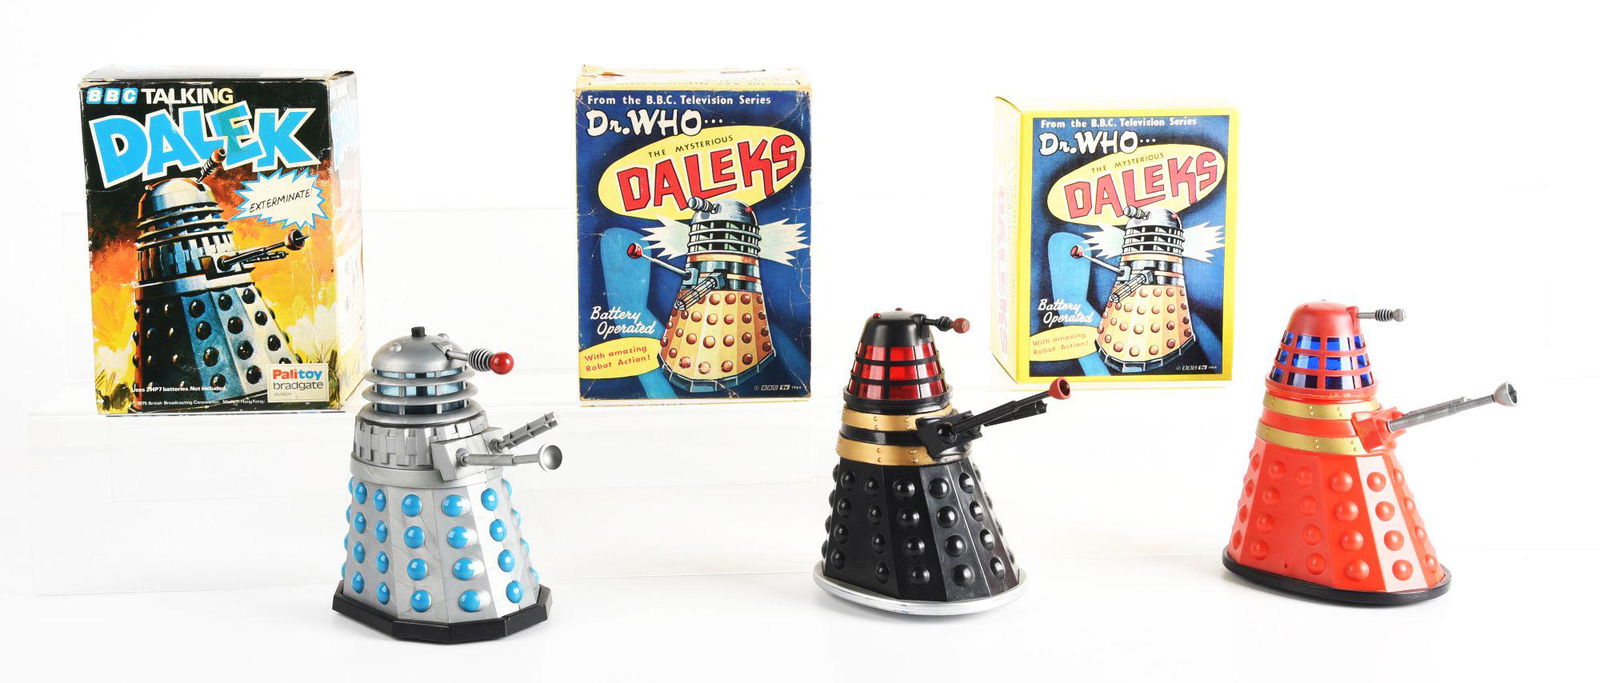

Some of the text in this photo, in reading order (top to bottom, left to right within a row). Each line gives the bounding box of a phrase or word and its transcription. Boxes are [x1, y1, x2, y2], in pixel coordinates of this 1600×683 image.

[86, 87, 234, 105] BBC TALKING
[587, 94, 771, 105] From the B.B.C. Television Series
[1040, 117, 1198, 128] From the B.B.C. Television Series
[89, 101, 321, 188] DALEK
[648, 135, 733, 159] THE MYSTERIOUS
[1091, 152, 1165, 173] THE MYSTERIOUS
[616, 134, 797, 212] DALEKS
[1064, 151, 1218, 220] DALEKS
[590, 305, 641, 324] Battery
[1037, 298, 1081, 315] Battery
[1043, 311, 1095, 328] Operated
[597, 320, 656, 340] Operated
[1053, 333, 1086, 343] amazing
[584, 346, 648, 362] With amazing
[585, 354, 651, 372] Robot Action!
[272, 369, 323, 380] Palitoy
[273, 381, 324, 391] bradgate
